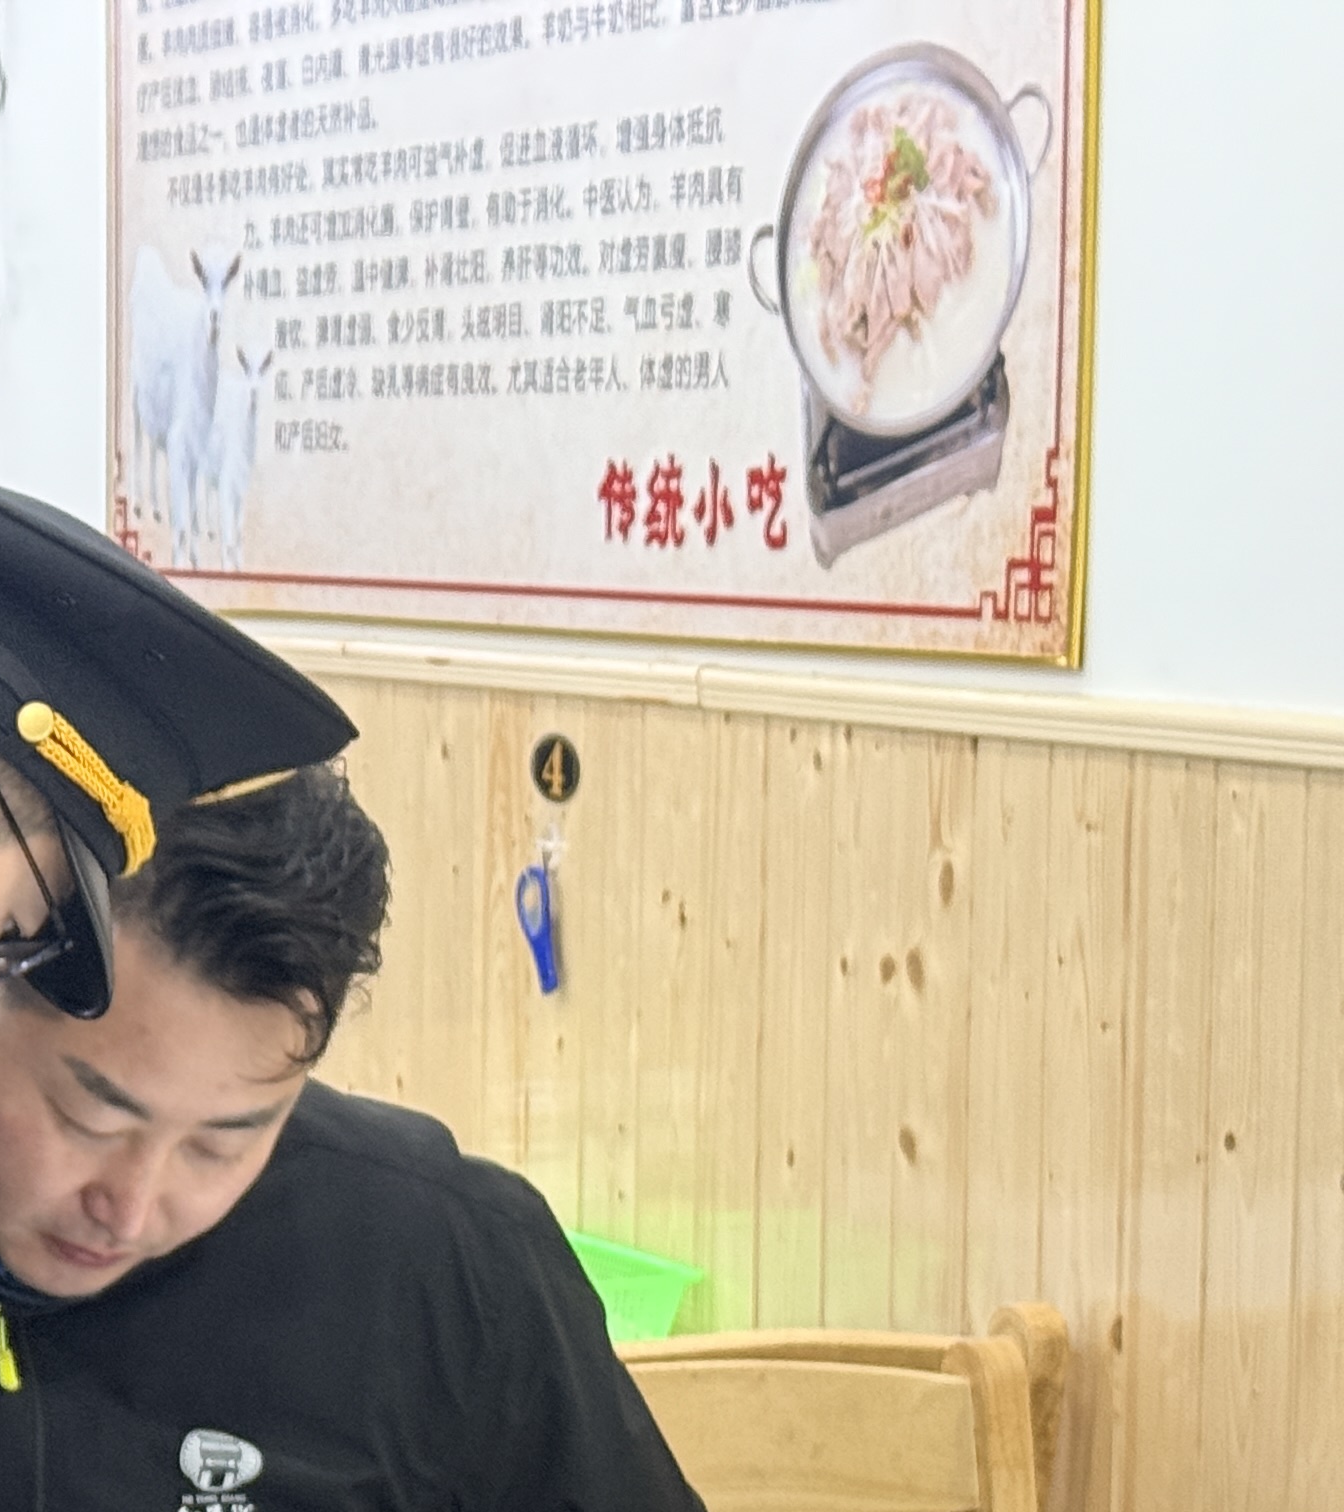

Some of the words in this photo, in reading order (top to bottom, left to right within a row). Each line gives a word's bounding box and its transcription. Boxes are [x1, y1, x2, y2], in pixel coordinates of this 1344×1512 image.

[598, 452, 786, 548] 传统小吃
[541, 740, 563, 797] 4
